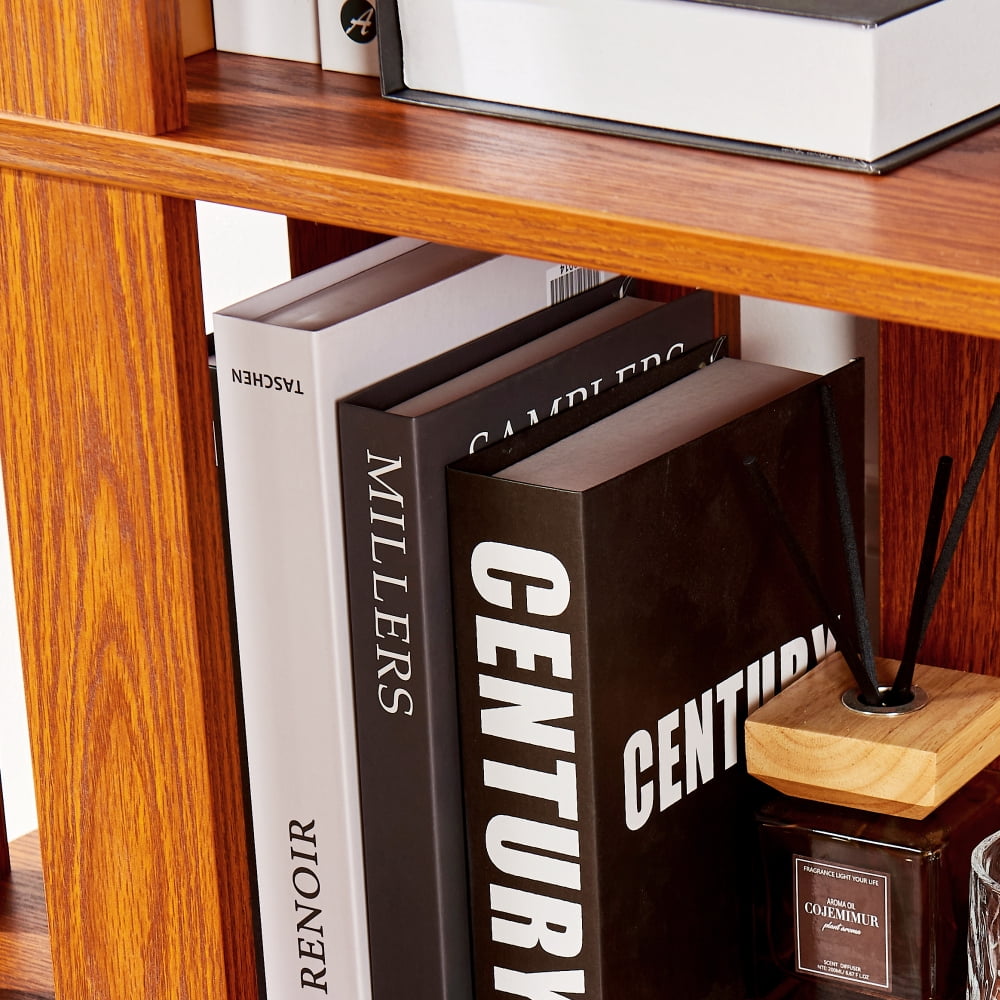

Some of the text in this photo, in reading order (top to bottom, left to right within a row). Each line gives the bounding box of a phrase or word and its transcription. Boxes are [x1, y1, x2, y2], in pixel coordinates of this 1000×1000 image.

[231, 368, 304, 395] TASCHEN
[366, 449, 414, 717] MILLERS
[803, 865, 879, 887] FRAGRANCE LIGHT YOUR LIFE
[288, 818, 329, 996] RENOIR
[804, 901, 880, 928] COJEMIMUR
[826, 897, 847, 908] AROMA
